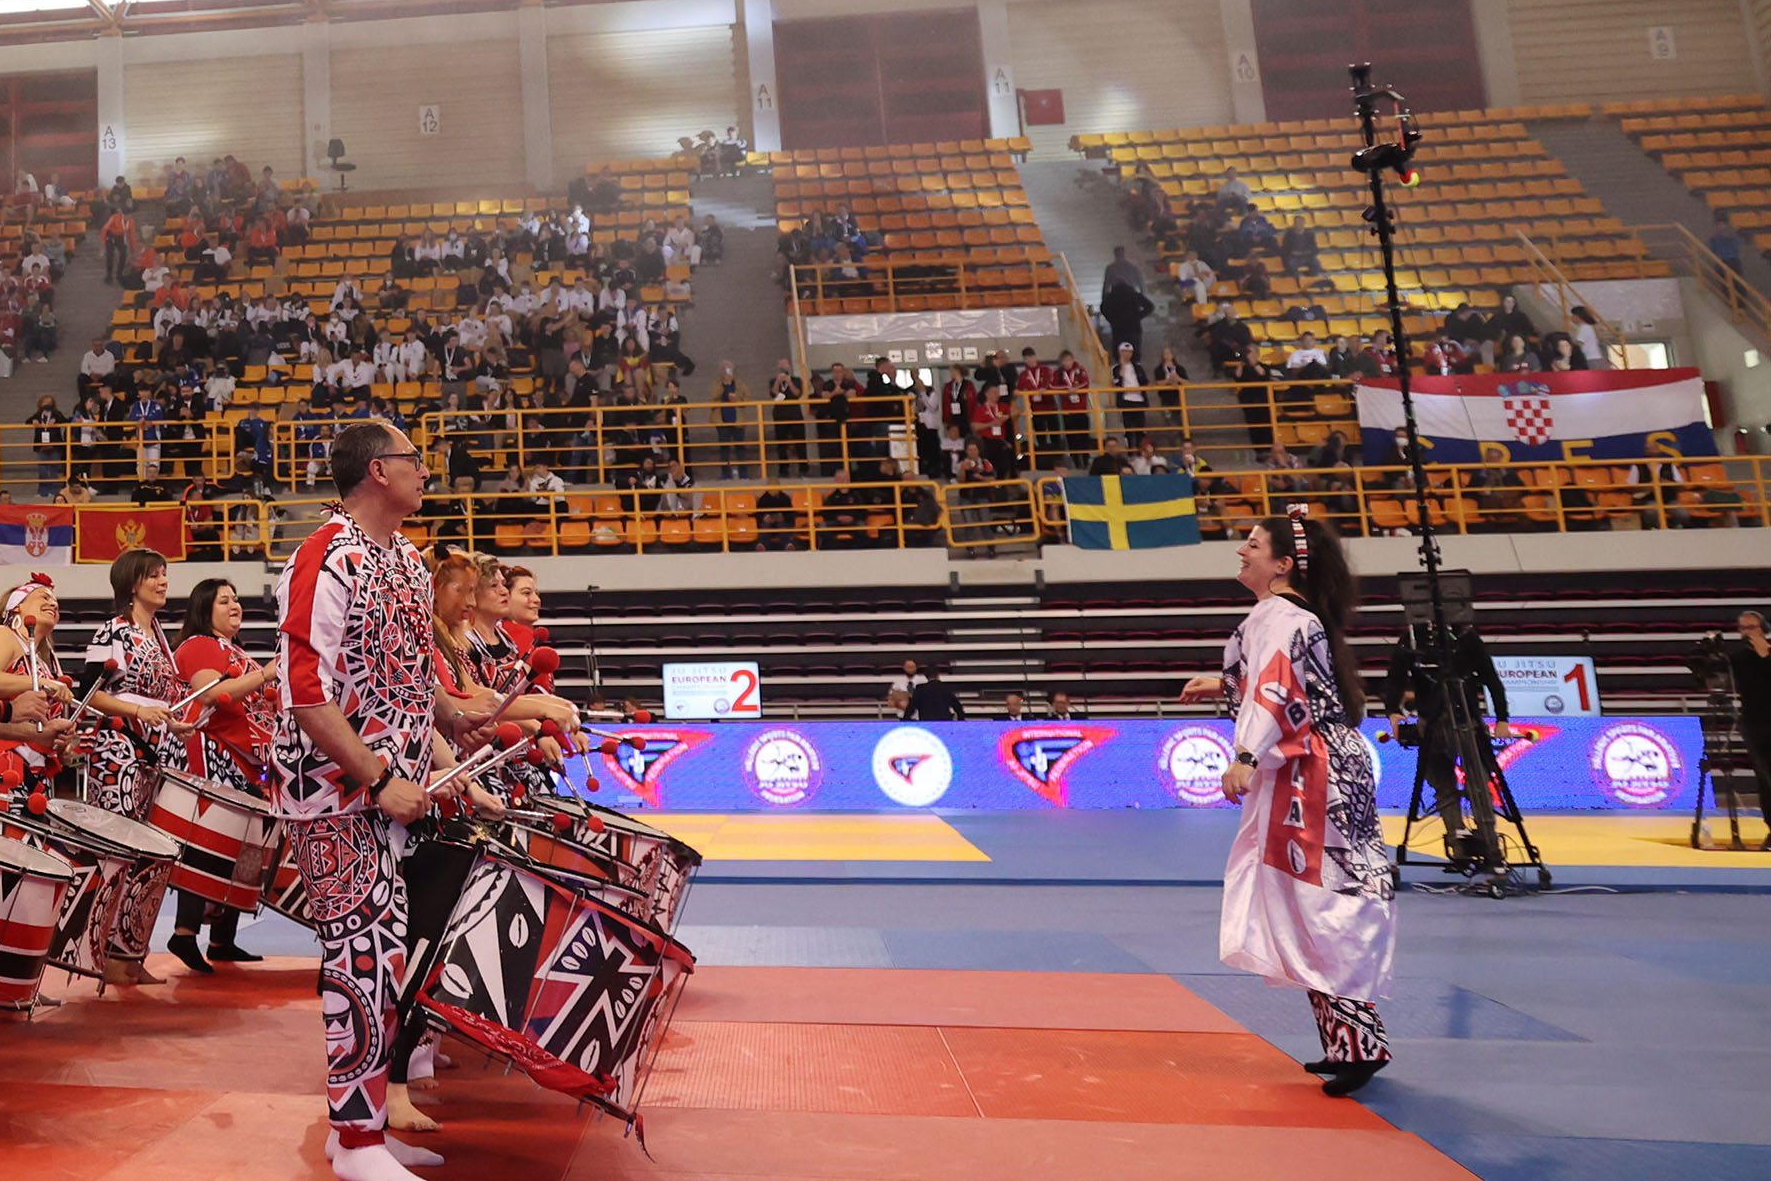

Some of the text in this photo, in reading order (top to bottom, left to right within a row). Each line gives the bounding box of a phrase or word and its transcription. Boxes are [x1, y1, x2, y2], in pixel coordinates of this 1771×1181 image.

[757, 97, 773, 109] 11
[422, 121, 438, 132] 12
[102, 138, 117, 150] 13
[1515, 660, 1557, 668] JITSU
[1498, 670, 1558, 678] UROPEAN
[671, 676, 727, 684] EUROPEAN
[730, 669, 759, 712] 2
[1563, 663, 1592, 712] 1
[1021, 729, 1083, 739] INTERNATIONAL
